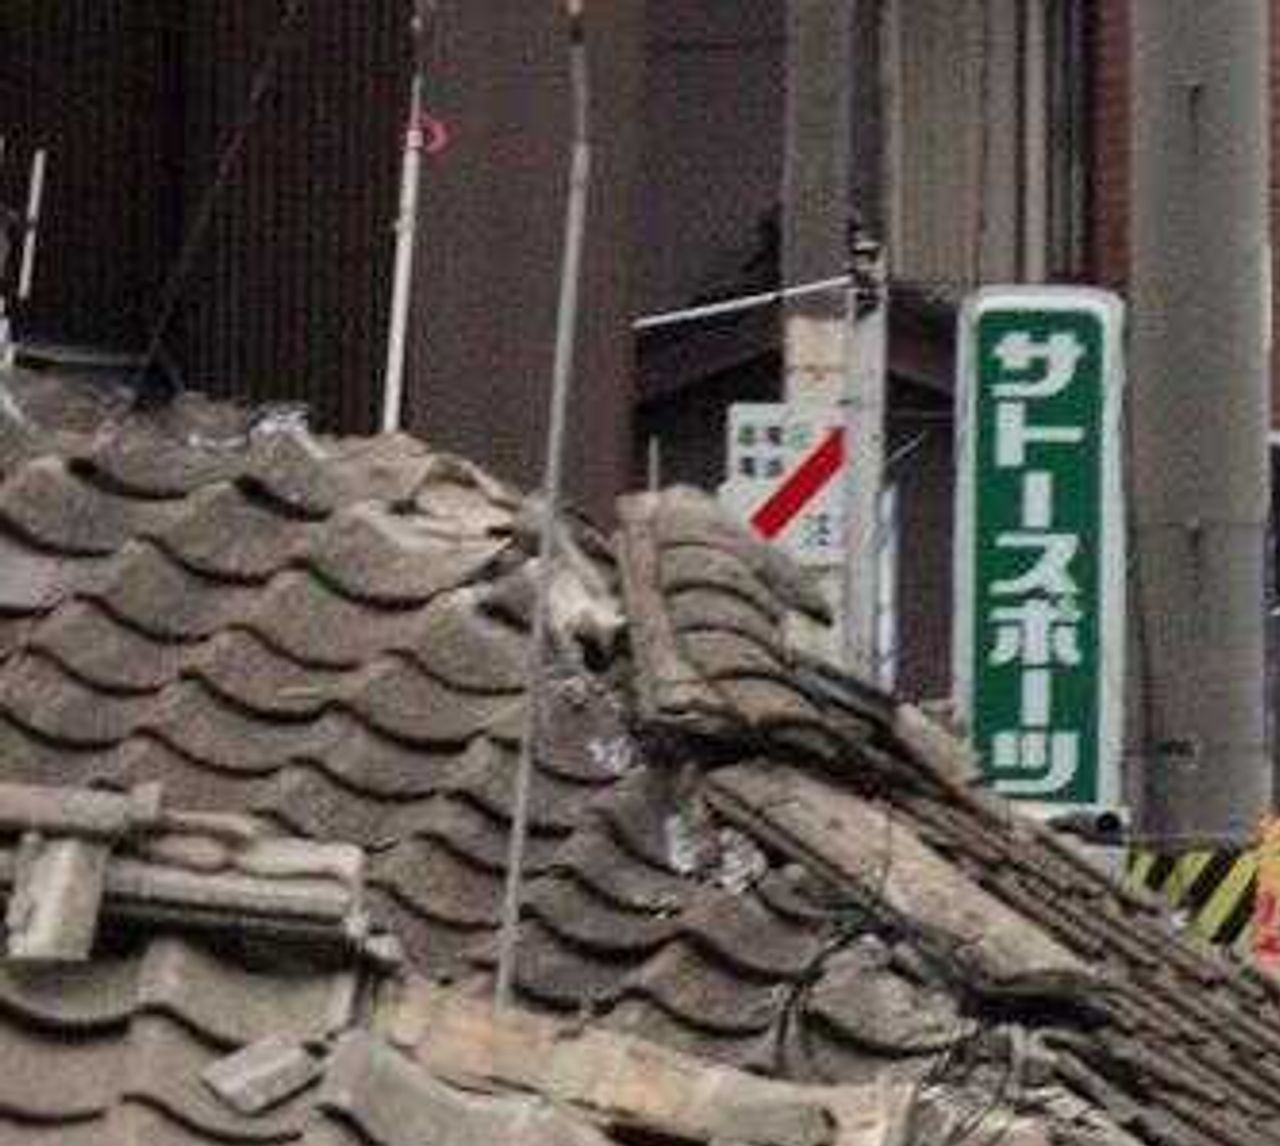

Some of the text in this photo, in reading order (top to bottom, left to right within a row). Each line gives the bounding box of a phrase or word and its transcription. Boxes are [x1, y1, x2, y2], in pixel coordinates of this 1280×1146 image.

[990, 332, 1085, 795] サトースポーツ
